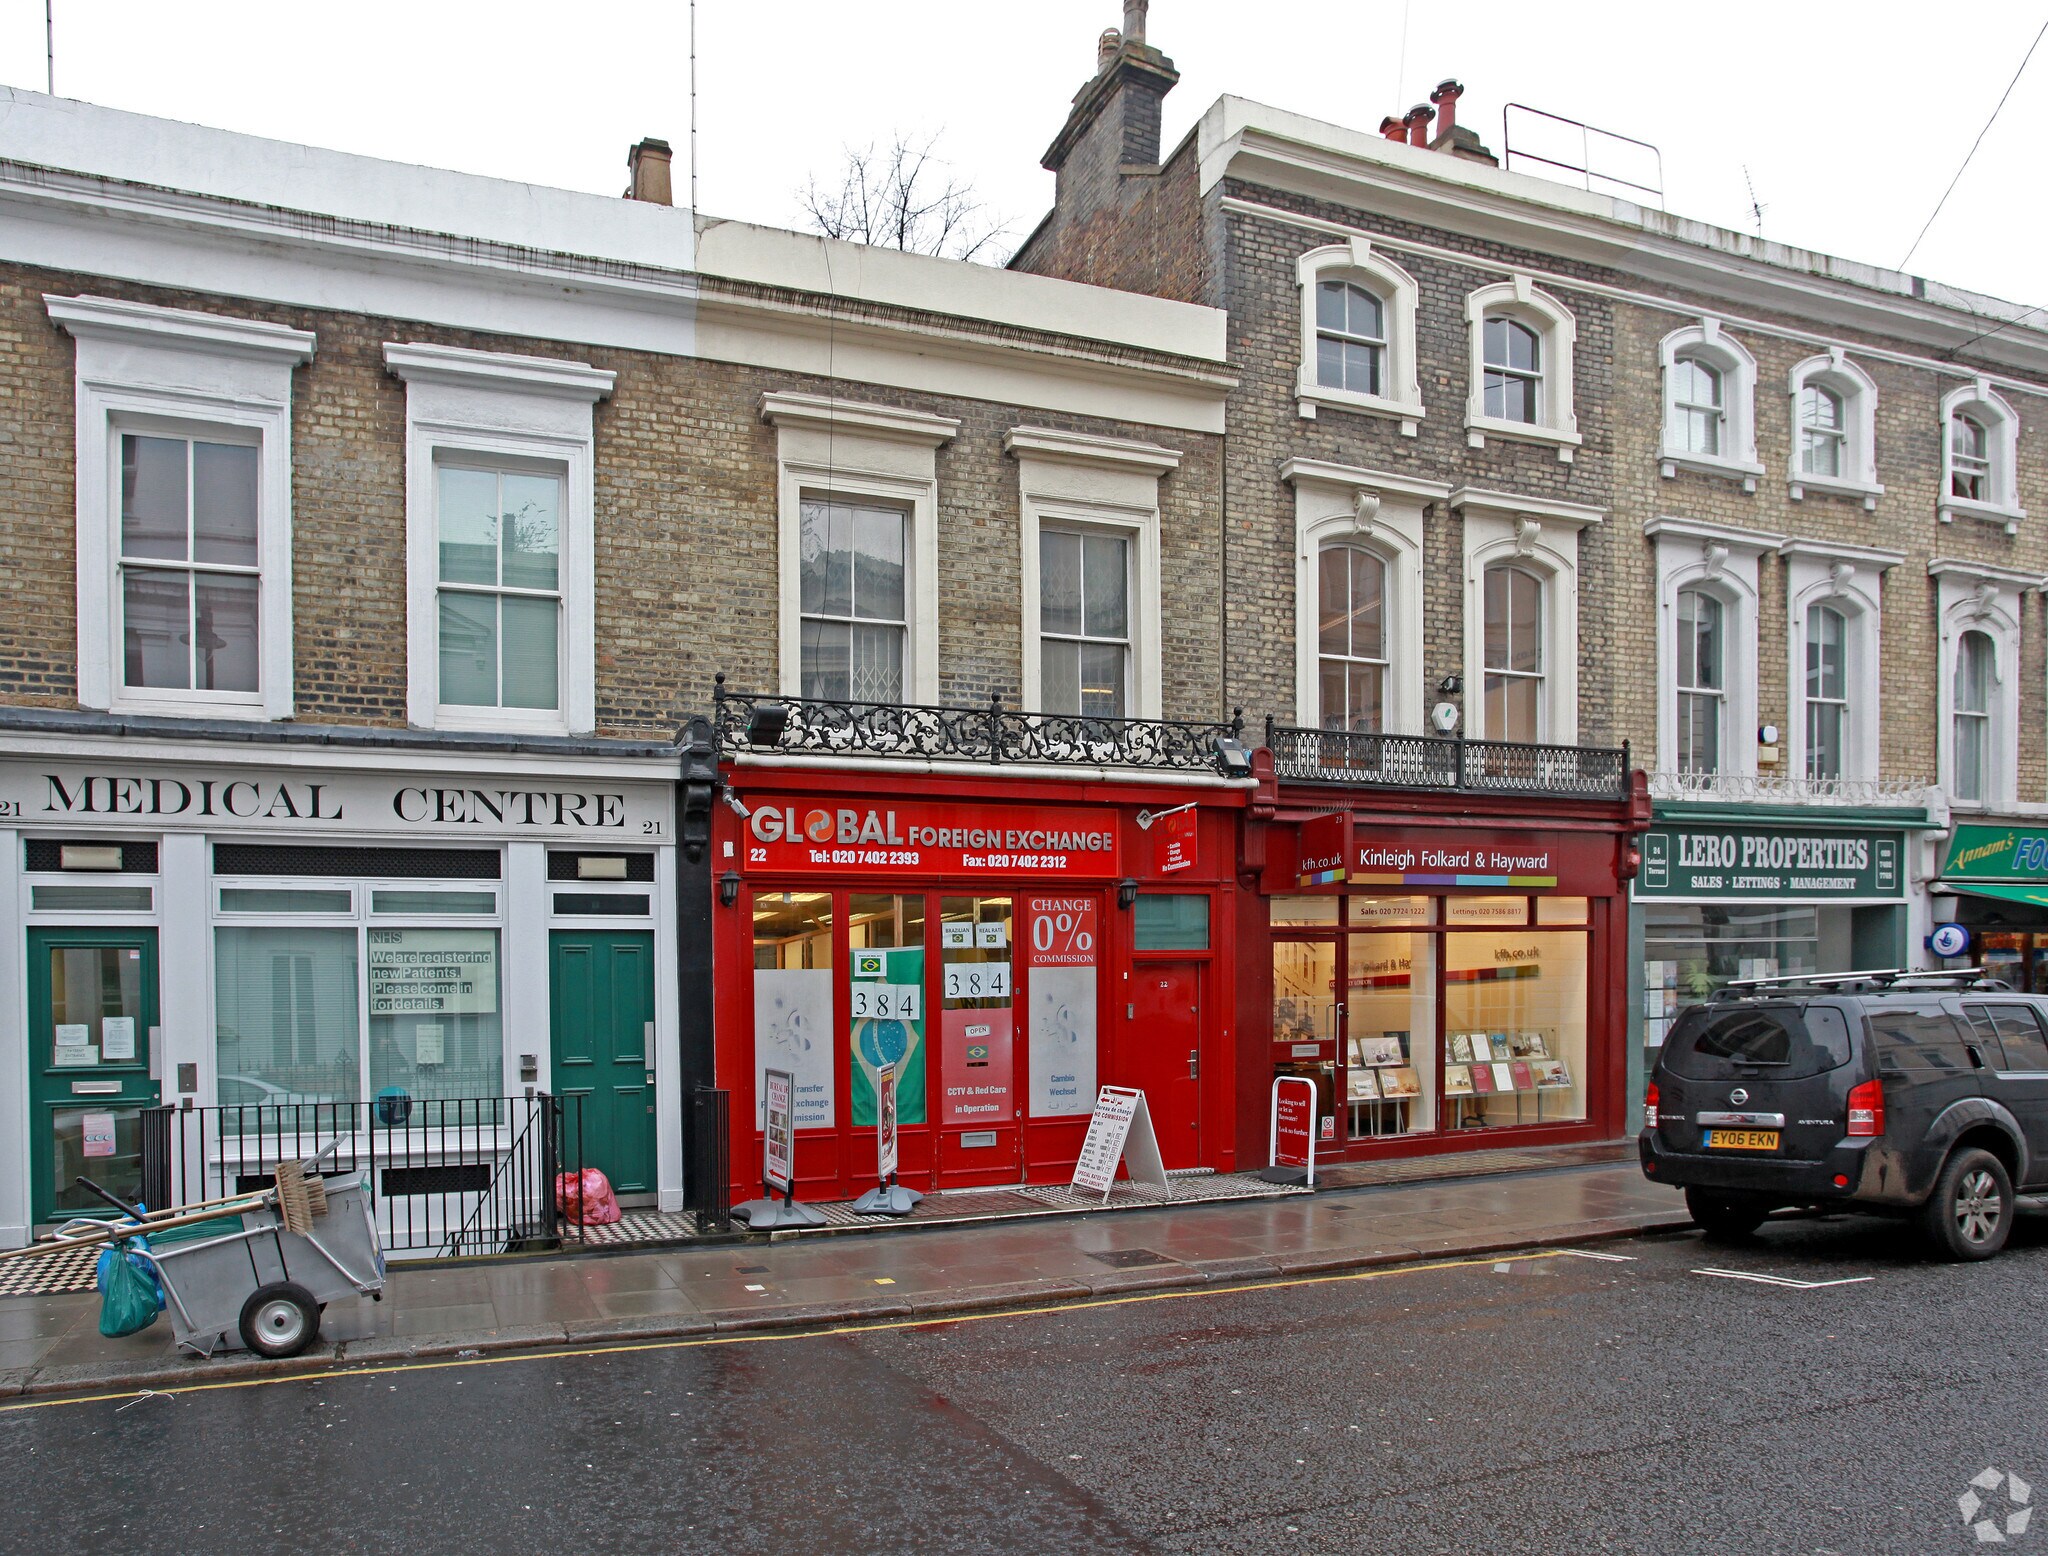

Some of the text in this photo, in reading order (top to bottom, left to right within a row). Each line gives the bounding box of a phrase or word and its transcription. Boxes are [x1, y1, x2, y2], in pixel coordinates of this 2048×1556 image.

[42, 774, 625, 827] MEDICAL CENTRE
[0, 800, 23, 817] 21
[751, 805, 904, 846] GLOBAL
[1335, 815, 1343, 824] 23
[642, 820, 662, 835] 21
[909, 826, 1113, 852] FOREIGN EXCHANGE
[750, 848, 767, 862] 22
[809, 849, 919, 865] Tel: 020 7402 2393
[1678, 834, 1868, 870] LERO PROPERTIES
[1947, 832, 2015, 871] Annam's
[963, 853, 1067, 869] Fax: 020 7402 2312
[1302, 852, 1342, 871] kfh.co.uk
[1360, 849, 1548, 872] Kinleigh Folkard & Hayward
[1691, 875, 1856, 889] SALES LETTINGS MANAGEMENT
[1031, 899, 1091, 911] CHANGE
[1452, 908, 1478, 917] Lettings
[370, 932, 403, 944] NHS
[1033, 912, 1093, 951] 0%
[371, 951, 492, 964] We are registering
[1033, 954, 1094, 963] COMMISSION
[372, 967, 462, 979] new Patients.
[372, 982, 473, 995] Please come in
[372, 998, 444, 1010] for details.
[969, 1026, 987, 1034] OPEN
[1050, 1074, 1075, 1083] Cambio
[947, 1084, 1007, 1096] CCTV & Red Care
[1049, 1088, 1077, 1096] Wechsel
[955, 1103, 999, 1114] in Operation
[1279, 1098, 1293, 1107] Looking
[1096, 1104, 1110, 1112] Bureau
[1117, 1107, 1132, 1116] change
[1101, 1112, 1129, 1122] COMMISSION
[1797, 1118, 1834, 1126] AVENTURA
[1711, 1130, 1776, 1147] EY06 EKN
